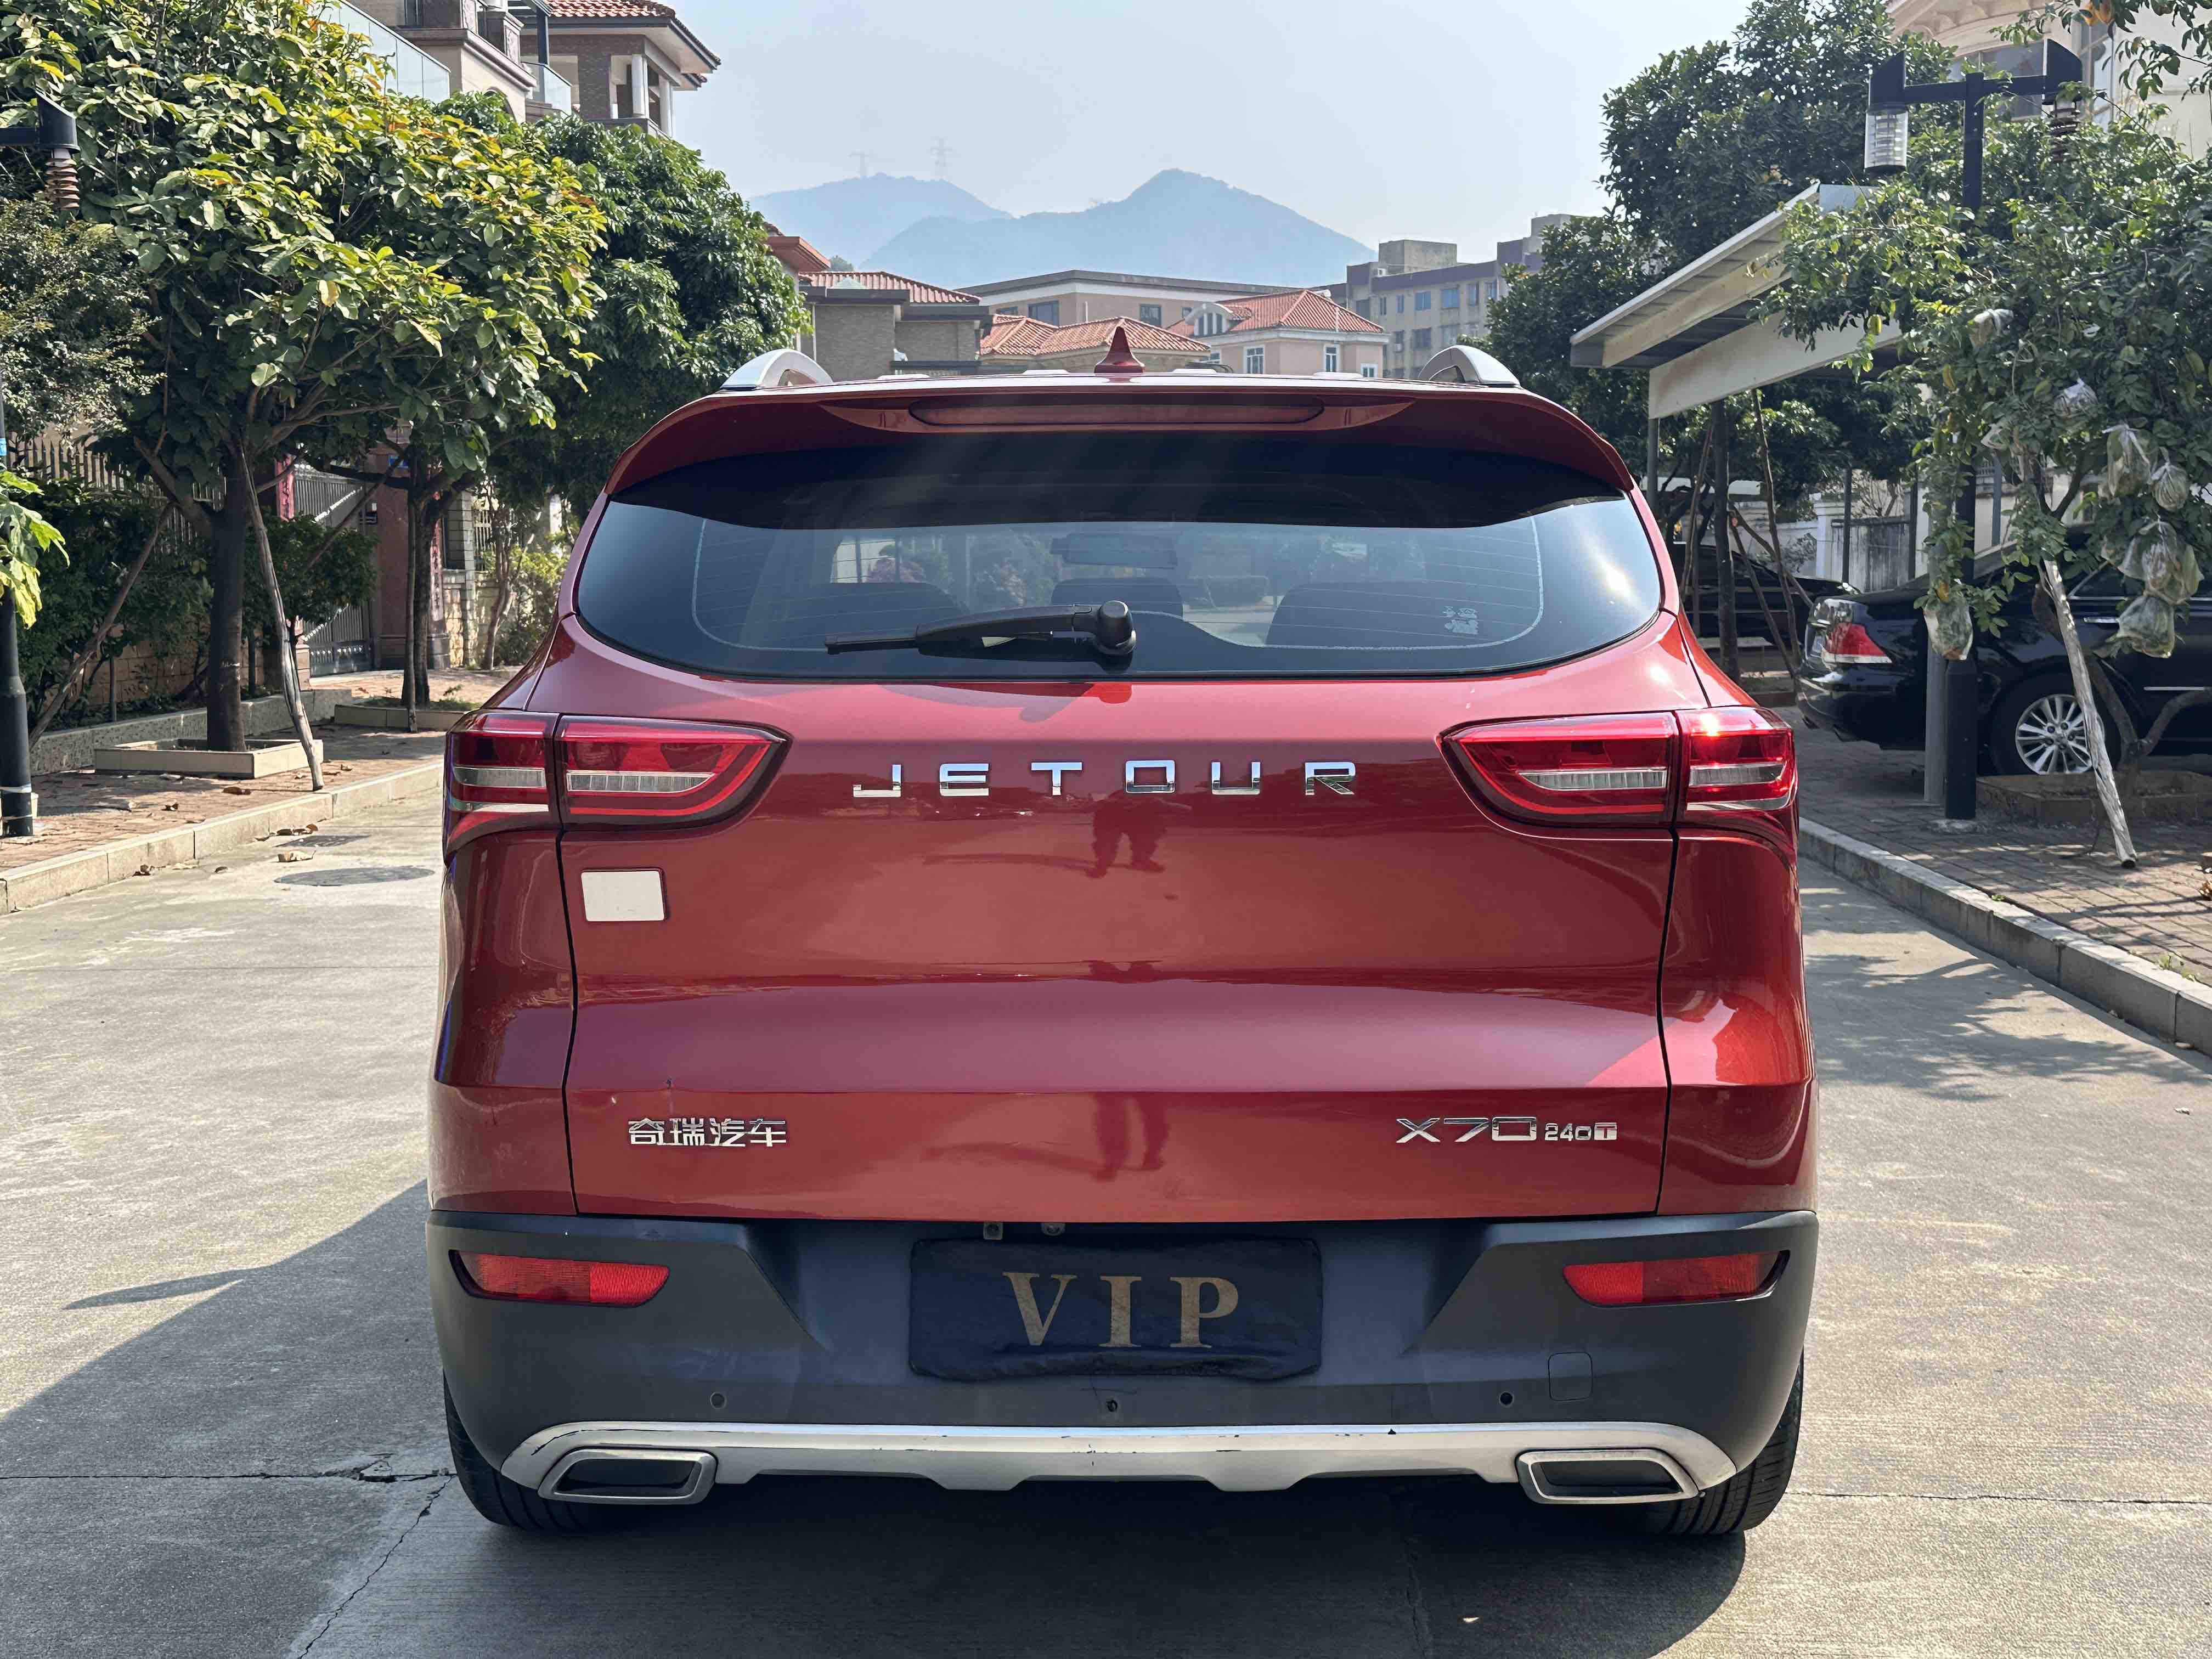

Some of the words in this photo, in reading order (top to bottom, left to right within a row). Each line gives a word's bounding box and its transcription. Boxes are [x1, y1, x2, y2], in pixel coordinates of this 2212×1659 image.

[853, 760, 1356, 798] JETOUR
[628, 1118, 787, 1147] 奇瑞汽车
[1396, 1116, 1537, 1143] X70
[1544, 1122, 1617, 1142] 240T
[1002, 1271, 1239, 1348] VIP
